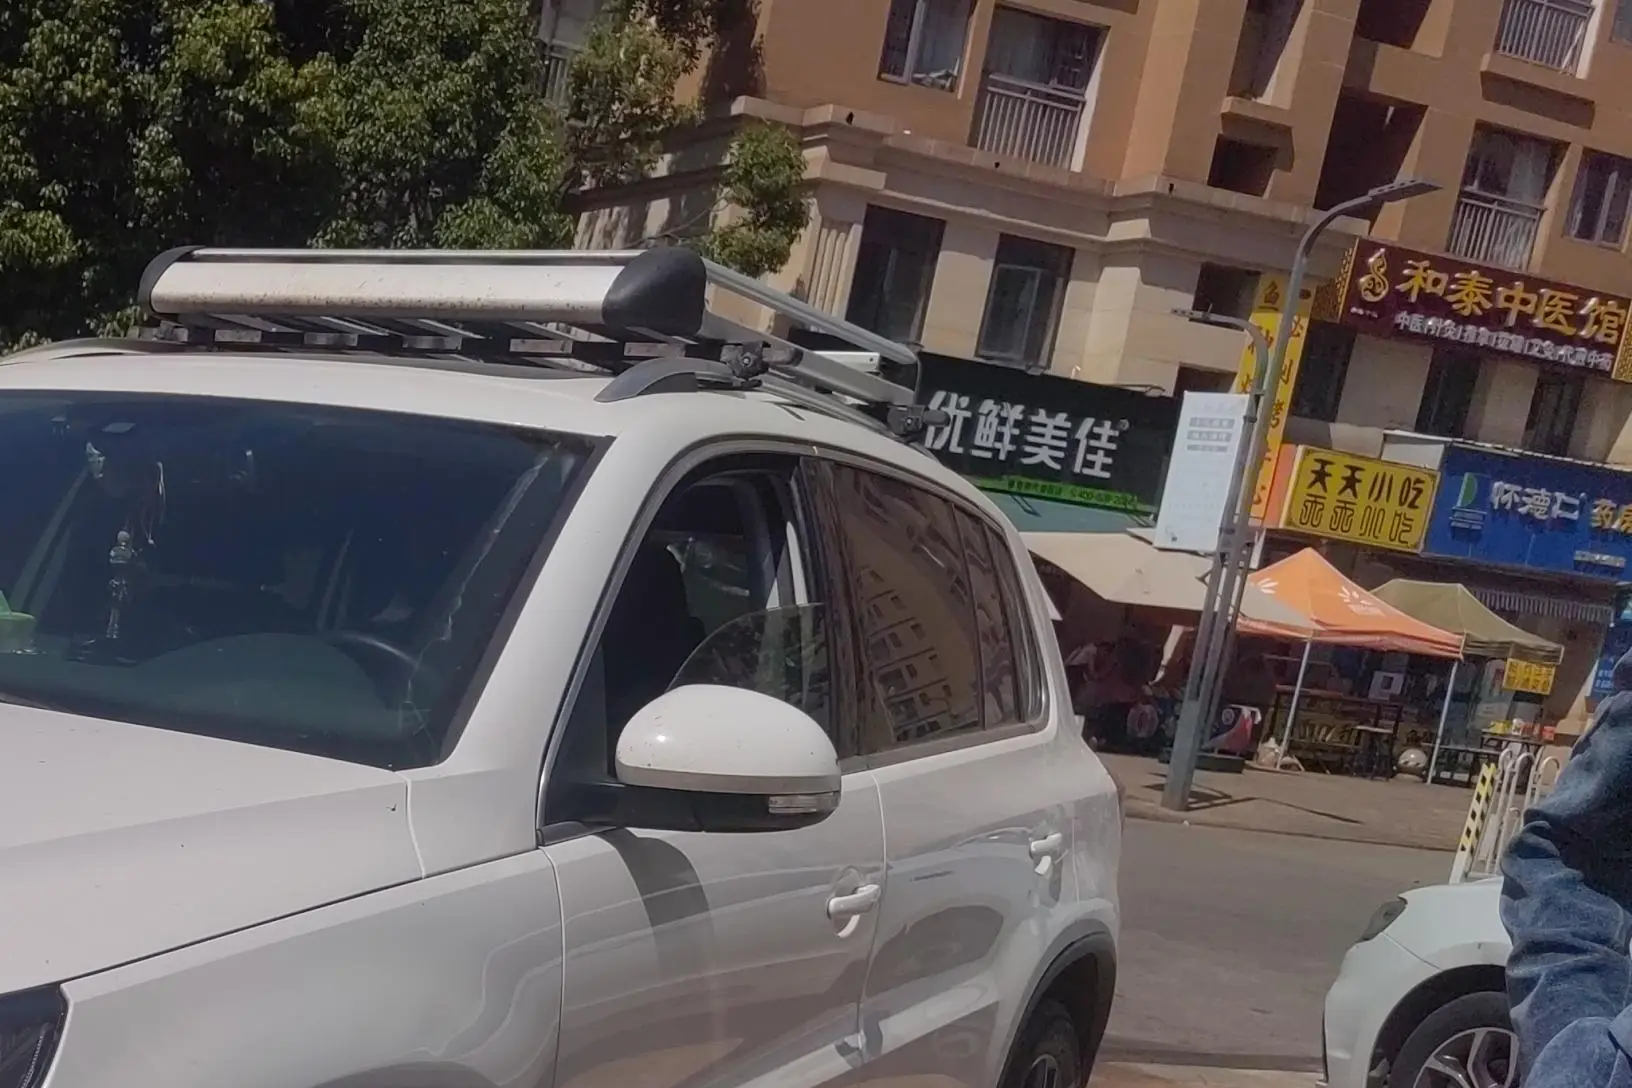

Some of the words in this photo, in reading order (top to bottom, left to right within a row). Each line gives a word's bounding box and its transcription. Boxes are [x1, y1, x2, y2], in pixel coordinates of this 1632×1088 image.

[1395, 259, 1626, 345] 和泰中医馆
[924, 390, 1120, 479] 优鲜美佳
[1307, 458, 1426, 510] 天天小吃
